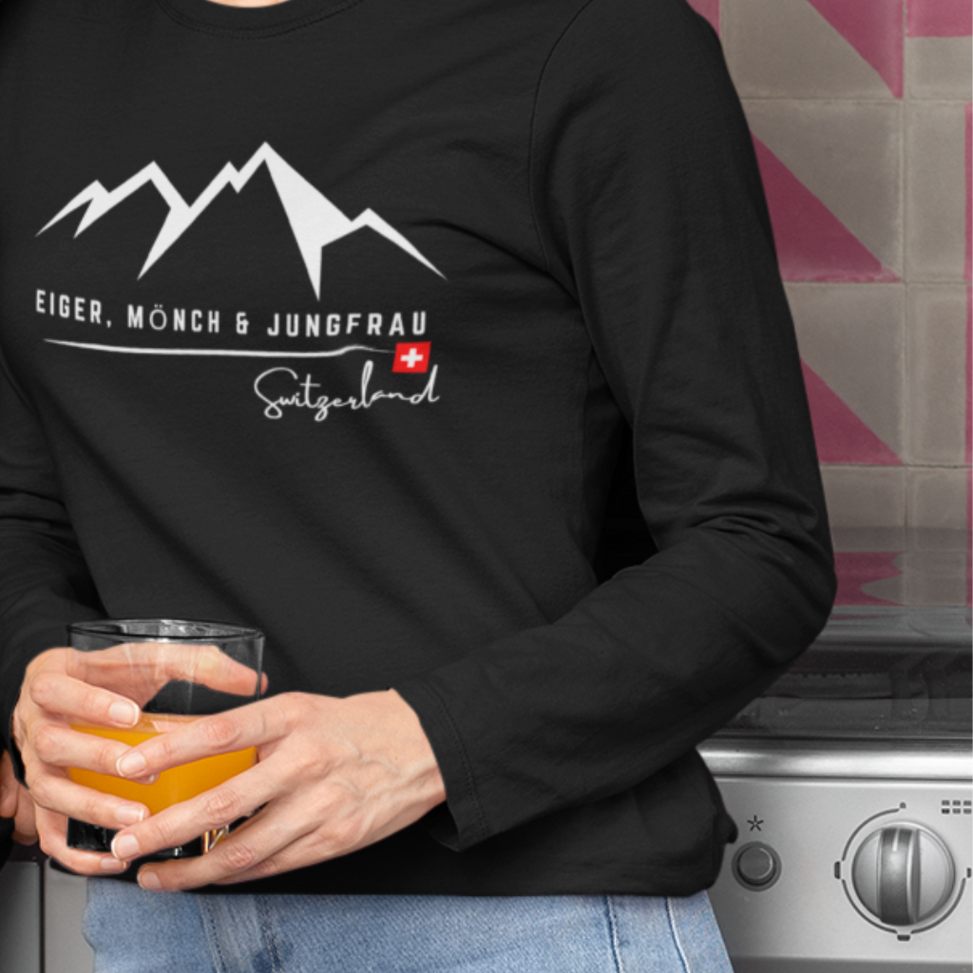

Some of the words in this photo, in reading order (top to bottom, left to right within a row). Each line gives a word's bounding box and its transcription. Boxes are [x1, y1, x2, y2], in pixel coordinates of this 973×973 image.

[35, 288, 113, 329] EIGER,
[127, 304, 220, 334] MÖNCH
[235, 311, 249, 335] &
[266, 311, 426, 338] JUNGFRAU
[253, 359, 441, 422] Switzerland
